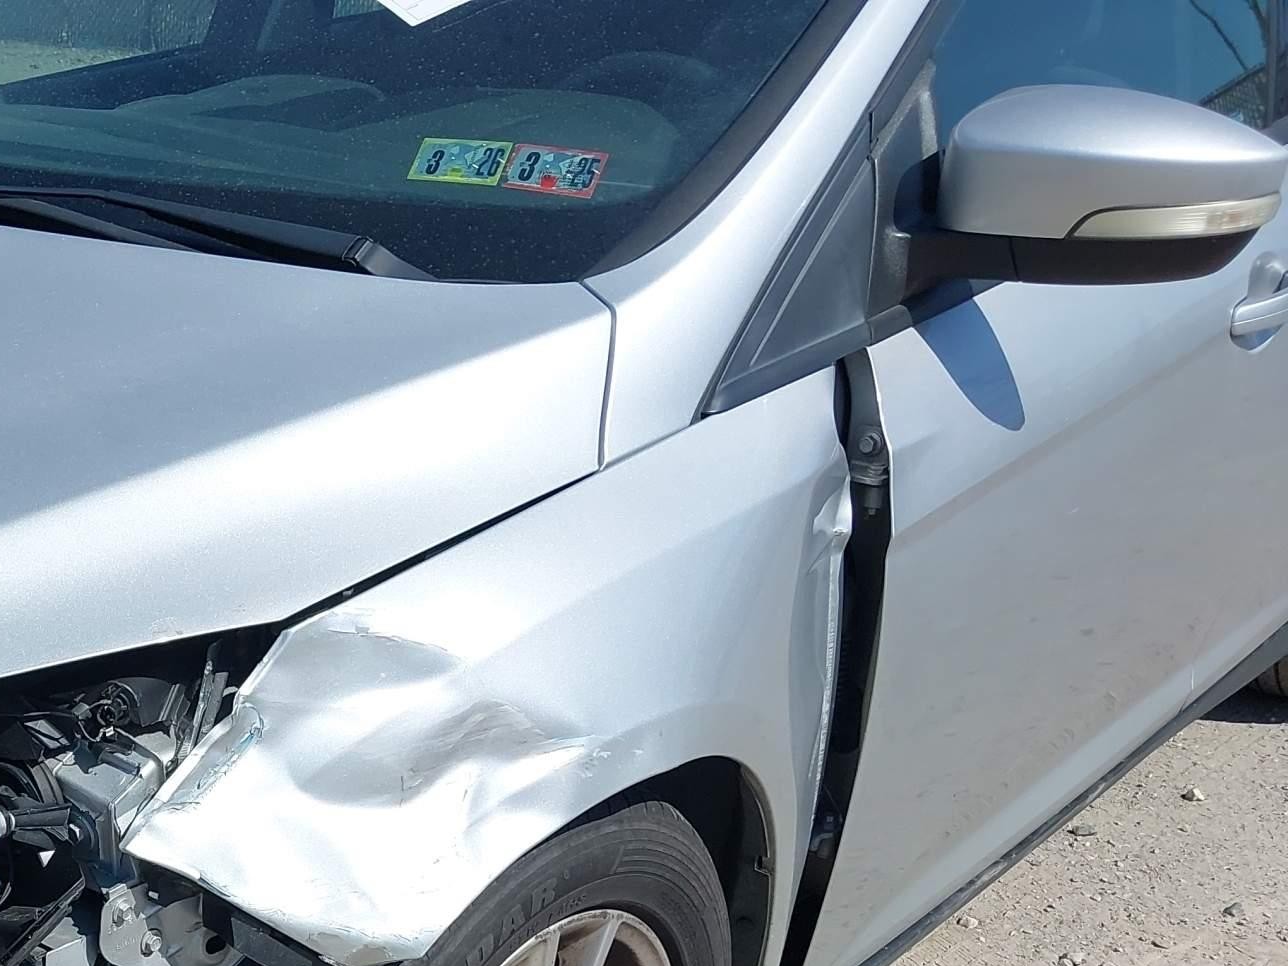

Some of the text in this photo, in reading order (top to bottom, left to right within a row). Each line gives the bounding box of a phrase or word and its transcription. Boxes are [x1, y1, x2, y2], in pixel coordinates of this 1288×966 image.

[425, 147, 506, 177] 3 26
[518, 151, 540, 181] 3
[571, 157, 601, 189] 25
